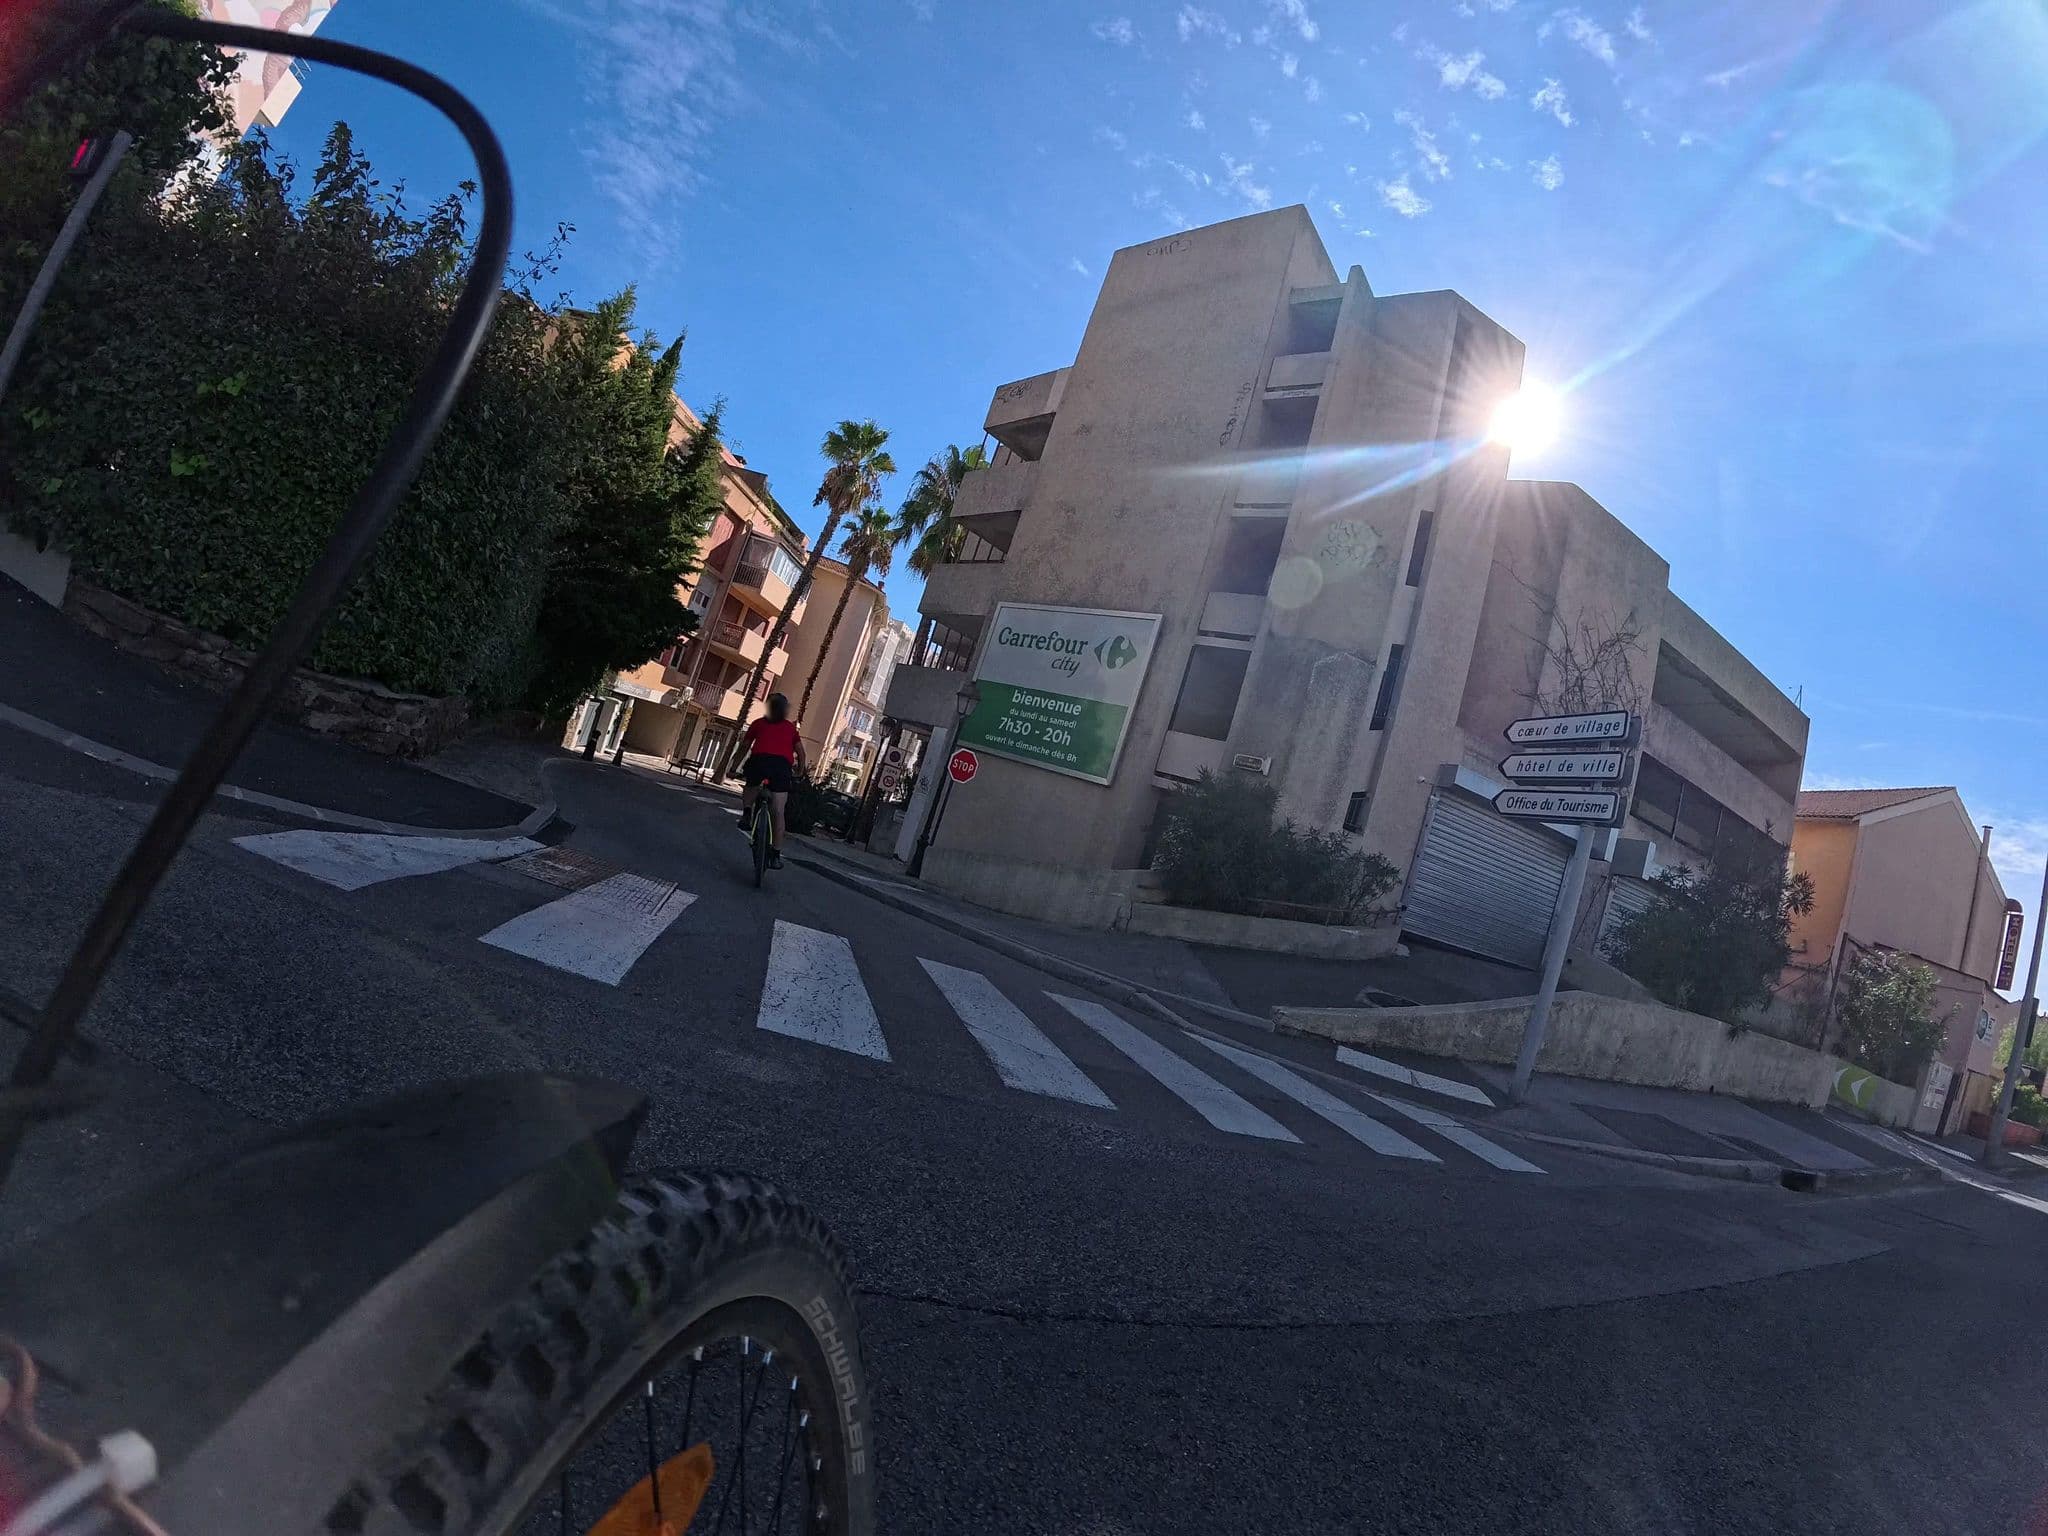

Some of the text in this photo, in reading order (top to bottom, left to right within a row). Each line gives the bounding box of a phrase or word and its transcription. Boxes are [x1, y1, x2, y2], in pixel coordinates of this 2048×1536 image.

[998, 626, 1089, 655] Carrefour
[1051, 656, 1081, 678] city
[1012, 690, 1082, 716] bienvenue
[1009, 708, 1078, 729] du lundi au samedi
[1517, 720, 1620, 738] cœur de village
[998, 717, 1032, 736] 7h30
[1043, 727, 1072, 746] 20h
[985, 734, 1007, 745] ouvert
[1007, 737, 1014, 746] le
[1015, 740, 1050, 756] dimanche
[1051, 749, 1065, 760] dès
[952, 758, 974, 773] STOP
[1516, 759, 1616, 772] hôtel de ville
[1506, 796, 1609, 814] Office du Tourisme
[803, 1295, 866, 1475] SCHWALBE
